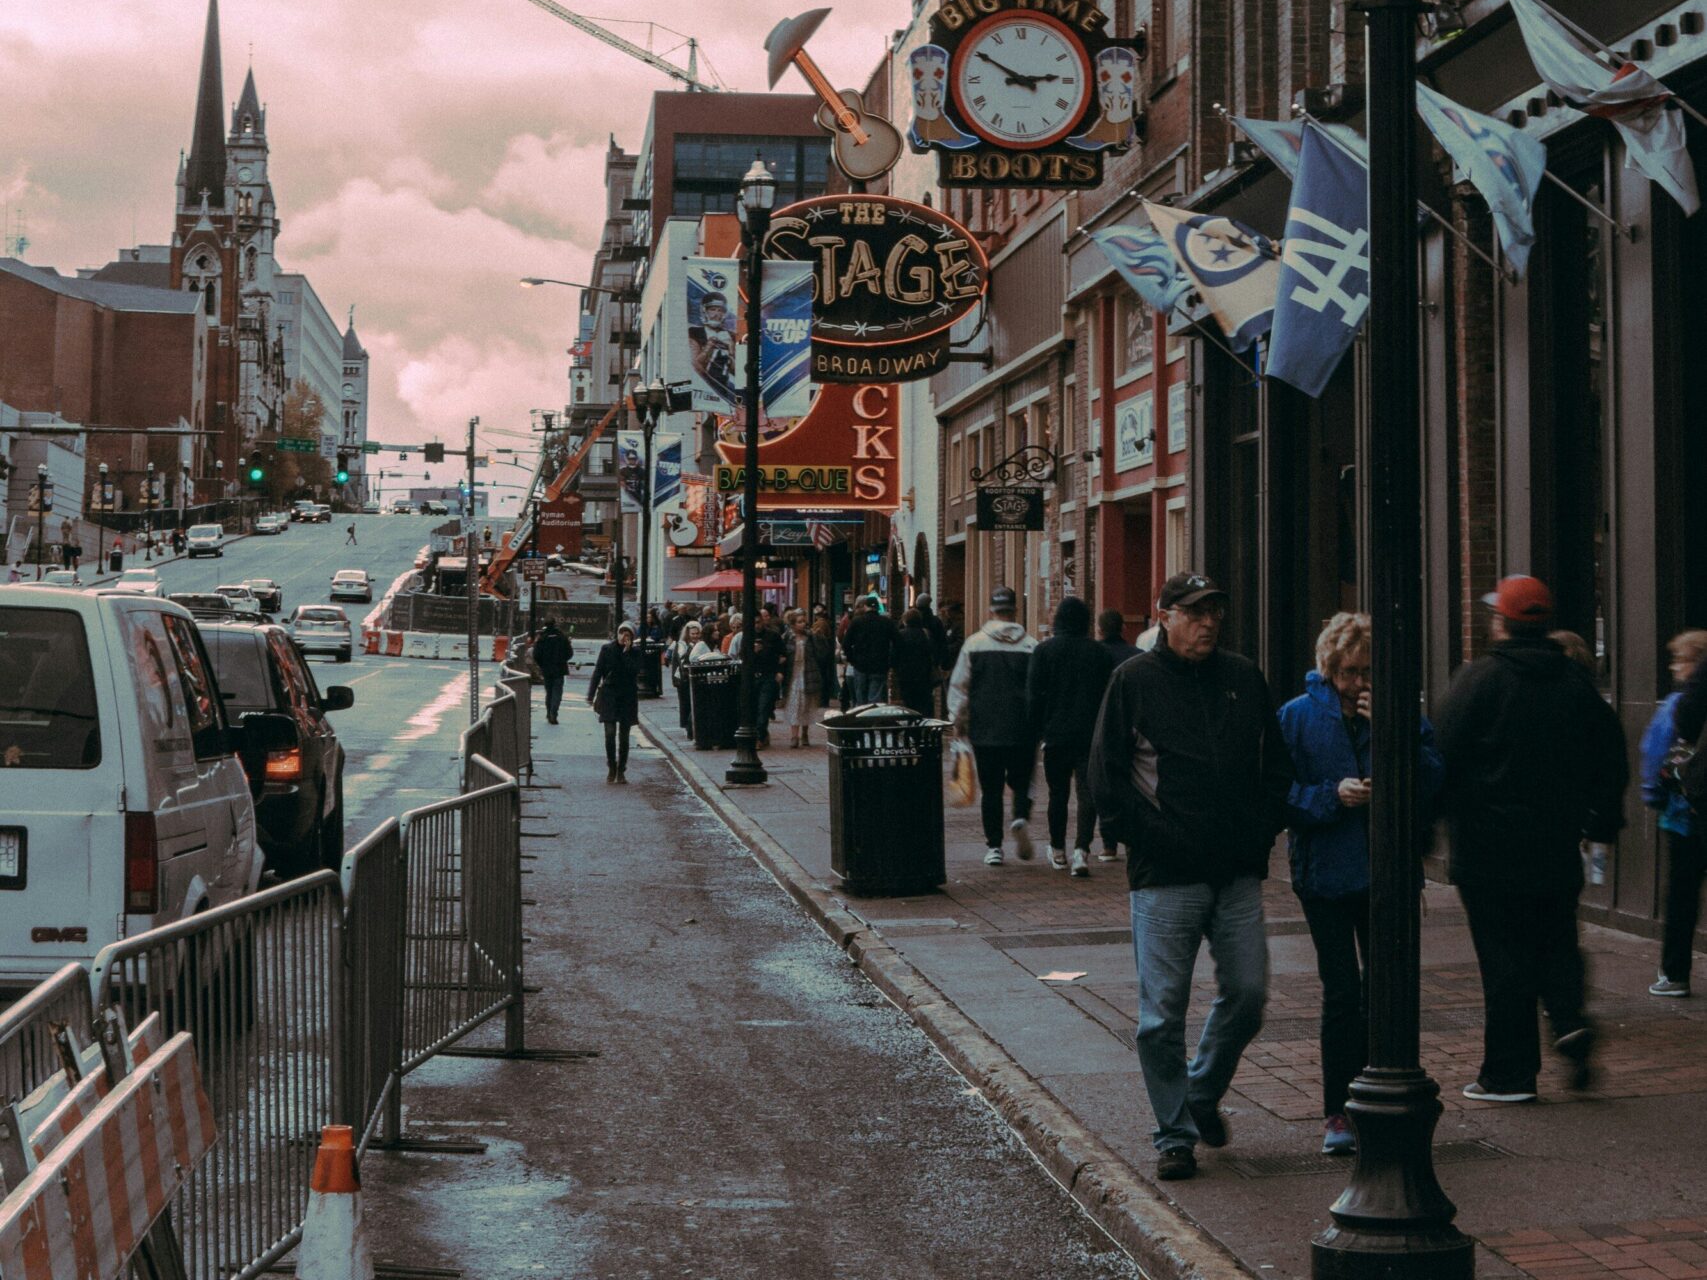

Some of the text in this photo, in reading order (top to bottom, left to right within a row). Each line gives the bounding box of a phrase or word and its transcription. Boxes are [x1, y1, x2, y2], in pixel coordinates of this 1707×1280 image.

[949, 152, 1097, 181] BOOTS
[839, 202, 886, 225] THE
[766, 318, 810, 330] TITAN
[784, 330, 807, 344] UP
[817, 350, 941, 375] BROADWAY
[719, 467, 848, 493] BAR-B-QUE
[992, 497, 1029, 512] STAGE
[541, 511, 565, 519] Ryman
[541, 519, 581, 527] Auditorium
[881, 748, 909, 756] Recycle
[31, 927, 88, 943] GMC
